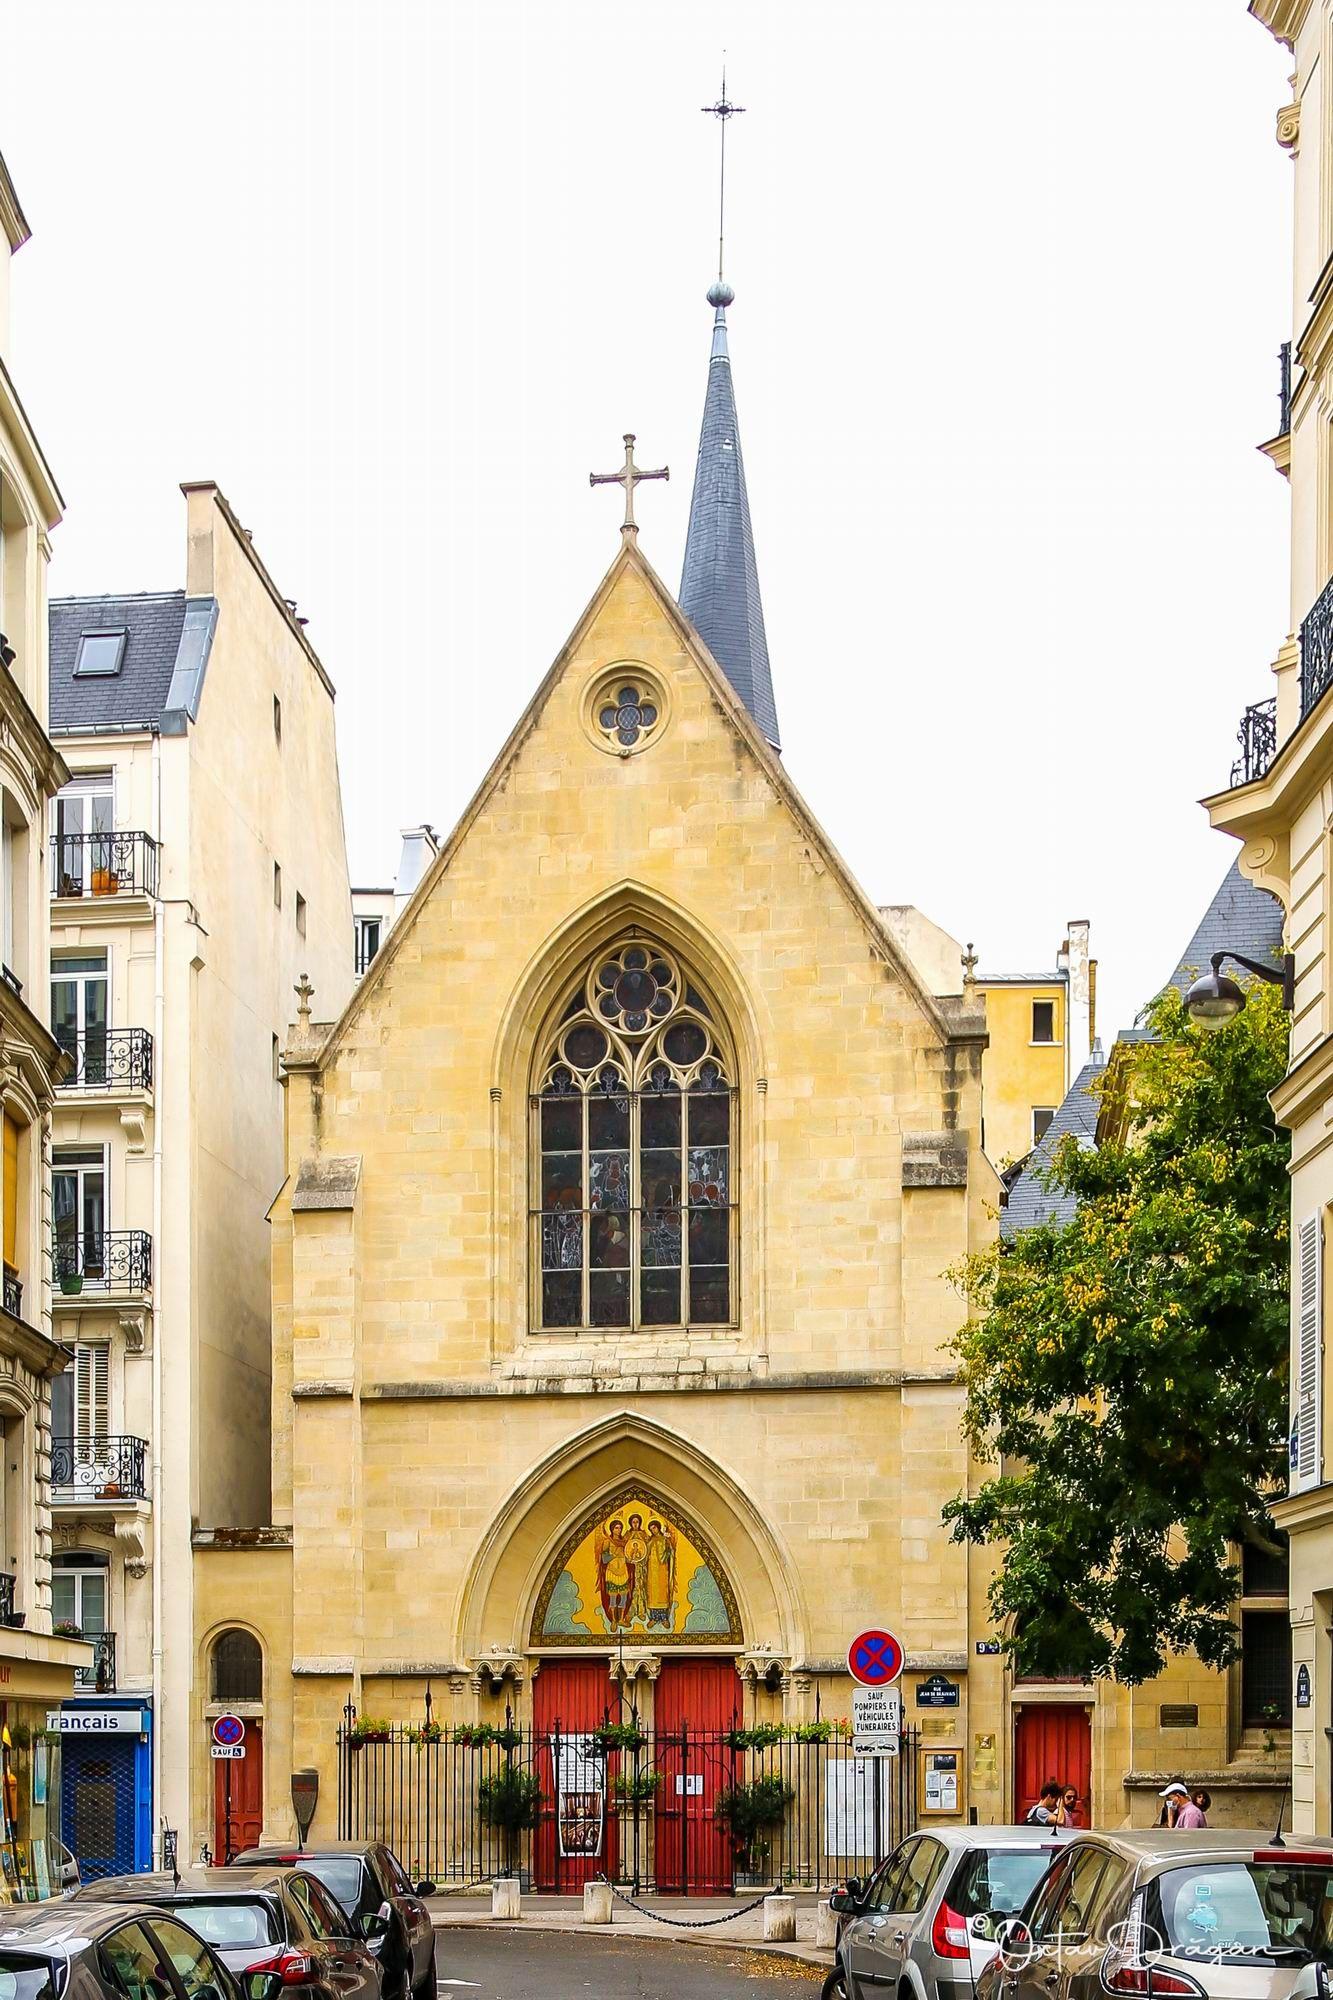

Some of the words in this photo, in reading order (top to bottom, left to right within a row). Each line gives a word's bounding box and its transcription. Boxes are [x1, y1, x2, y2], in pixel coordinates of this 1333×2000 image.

[979, 1642, 986, 1653] 9
[867, 1691, 884, 1701] SAUF
[854, 1702, 887, 1711] POMPIERS
[889, 1702, 897, 1710] ET
[212, 1748, 232, 1756] SAUF
